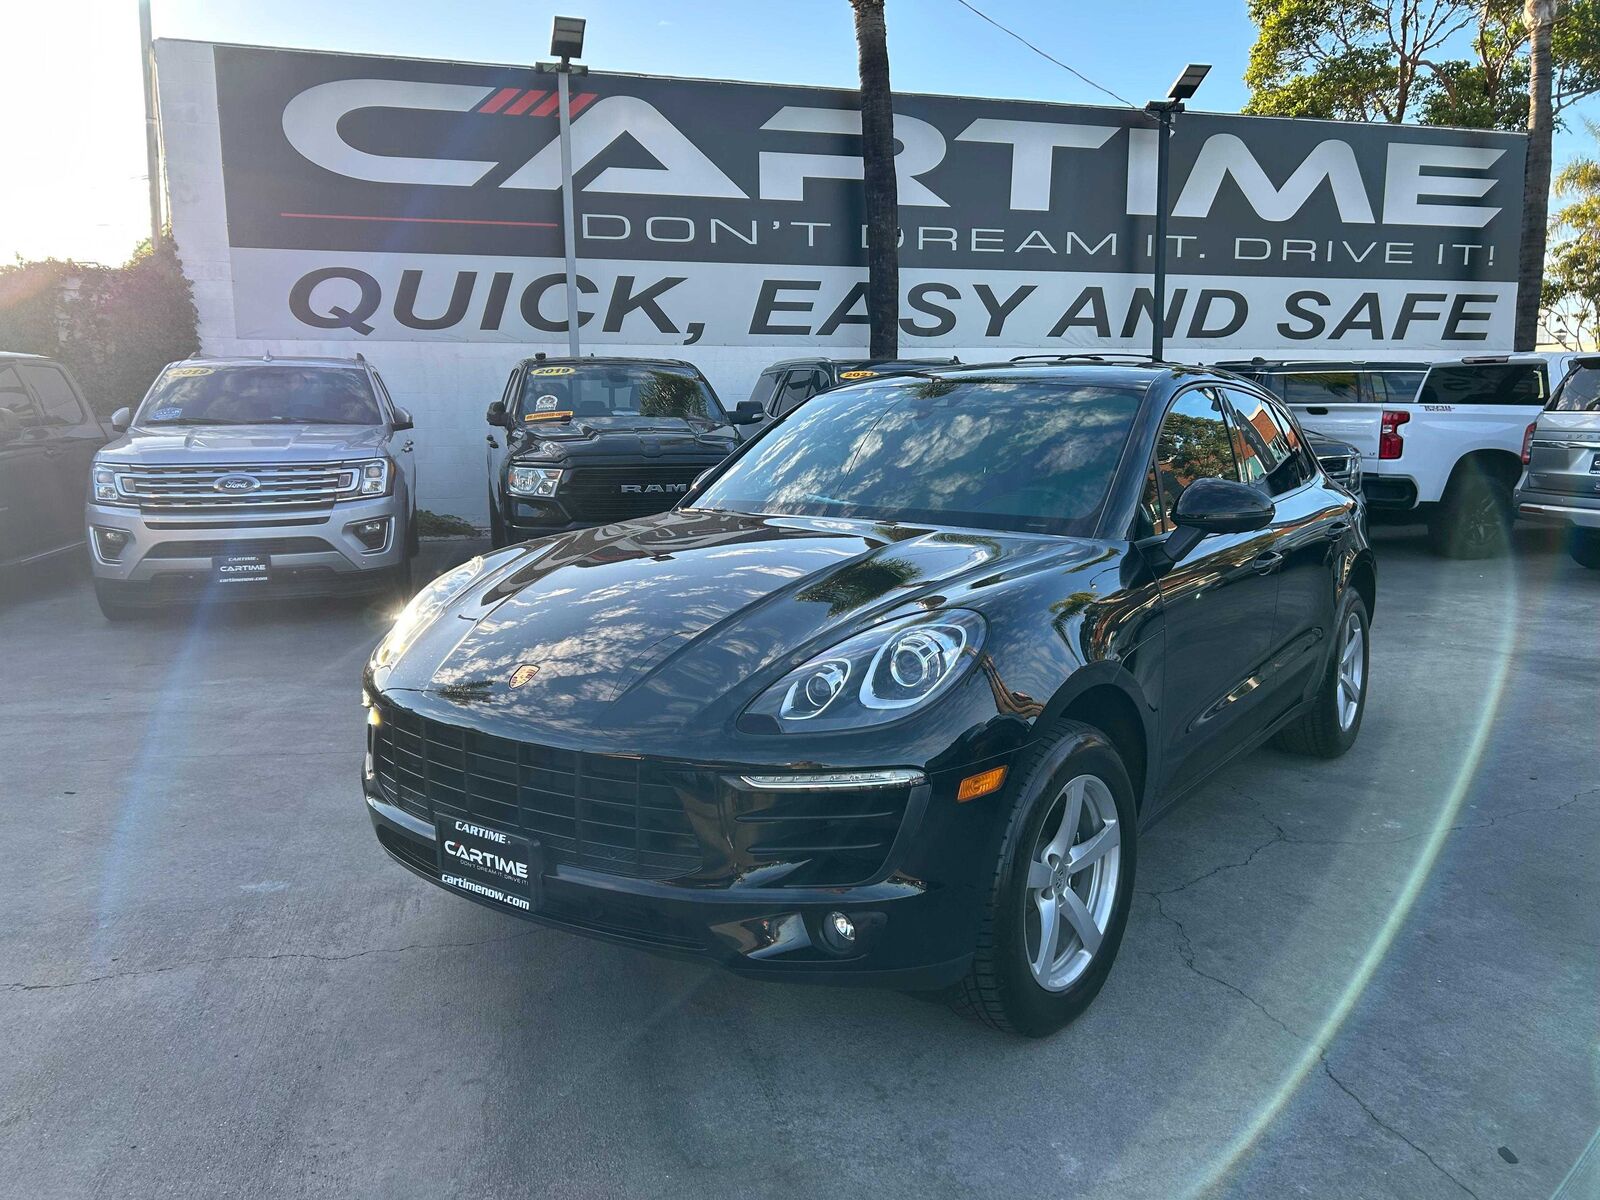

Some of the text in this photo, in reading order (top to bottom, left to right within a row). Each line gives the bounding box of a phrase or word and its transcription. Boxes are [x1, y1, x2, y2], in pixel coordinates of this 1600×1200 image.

[281, 78, 1507, 228] CARTIME
[582, 213, 831, 246] DON'T
[1234, 237, 1414, 263] DRIVE
[1437, 243, 1495, 266] IT!
[288, 266, 1499, 346] QUICK, EASY AND SAFE
[536, 367, 570, 375] 2019
[225, 480, 247, 488] Ford
[621, 484, 687, 493] RAM
[455, 821, 507, 844] CARTIME
[444, 840, 529, 879] CARTIME
[441, 873, 530, 911] cartimenow.com
